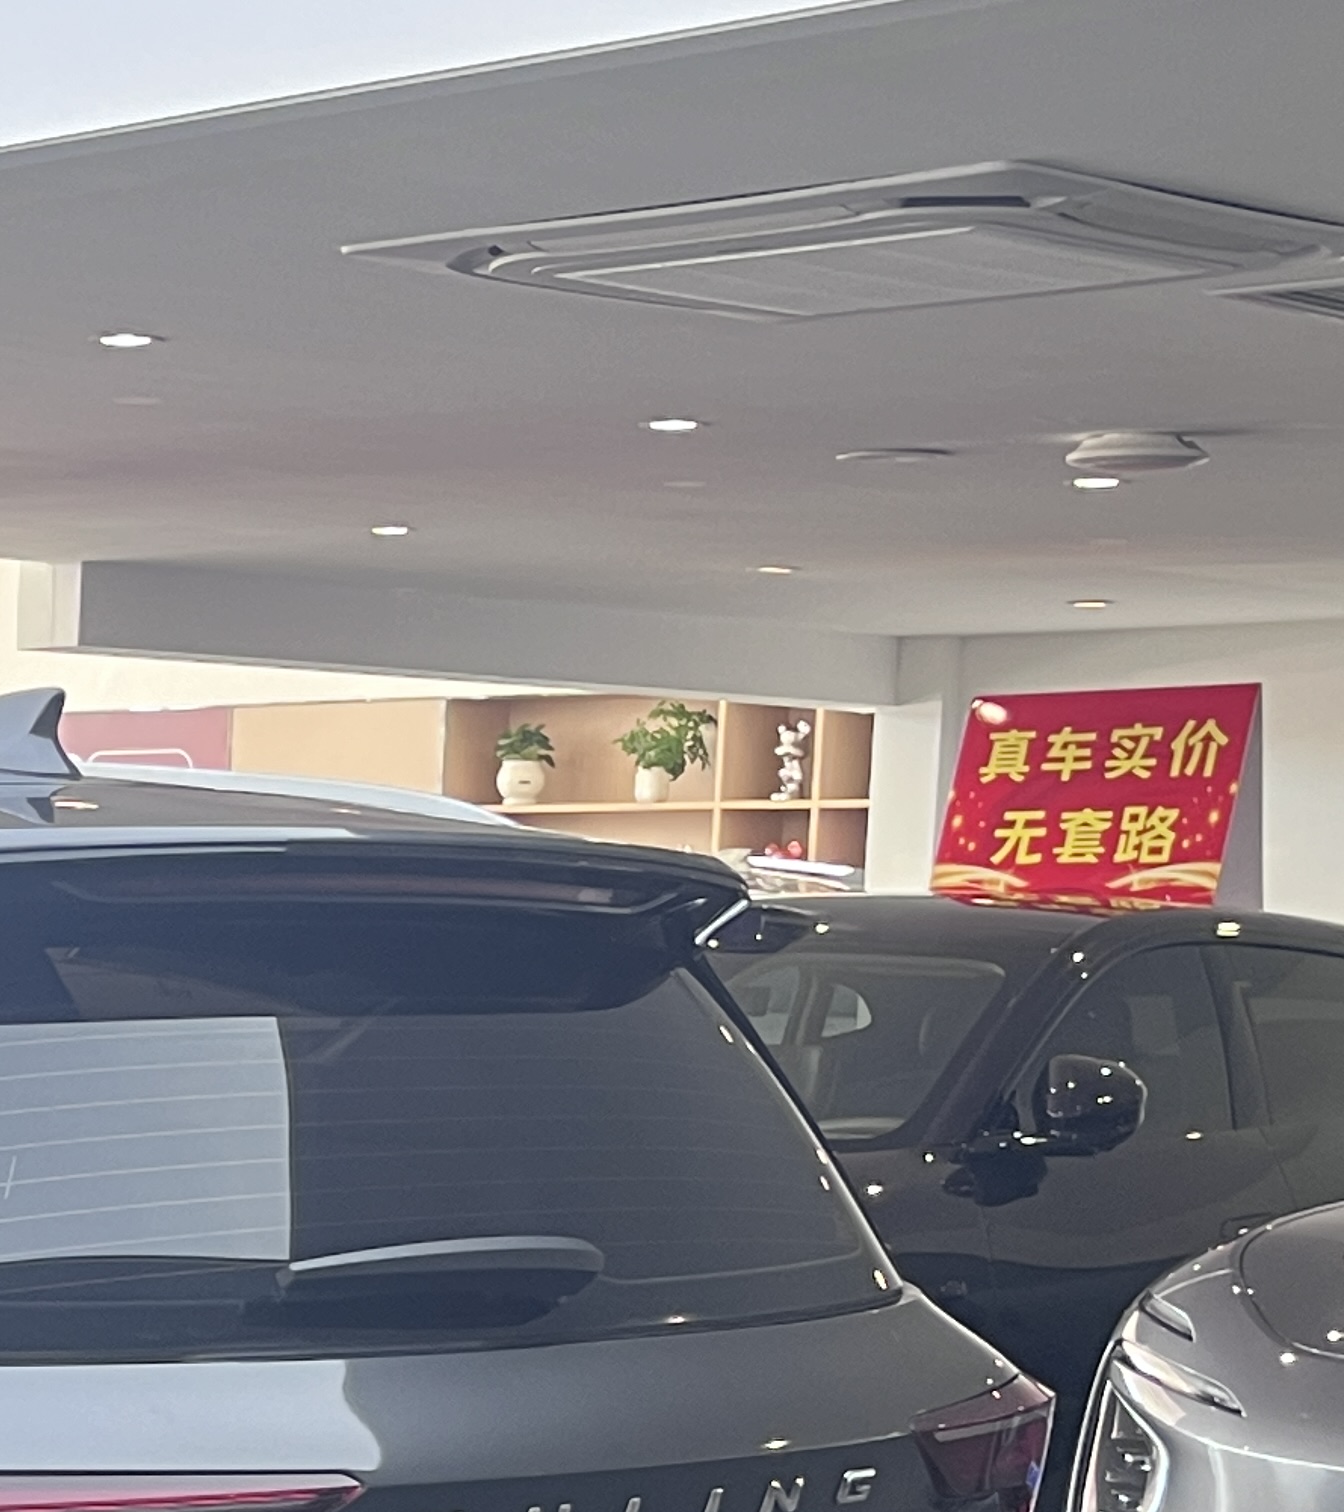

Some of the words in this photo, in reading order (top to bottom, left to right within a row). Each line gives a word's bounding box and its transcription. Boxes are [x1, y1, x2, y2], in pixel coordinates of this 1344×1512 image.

[979, 717, 1230, 784] 真车实价
[989, 805, 1181, 867] 无套路
